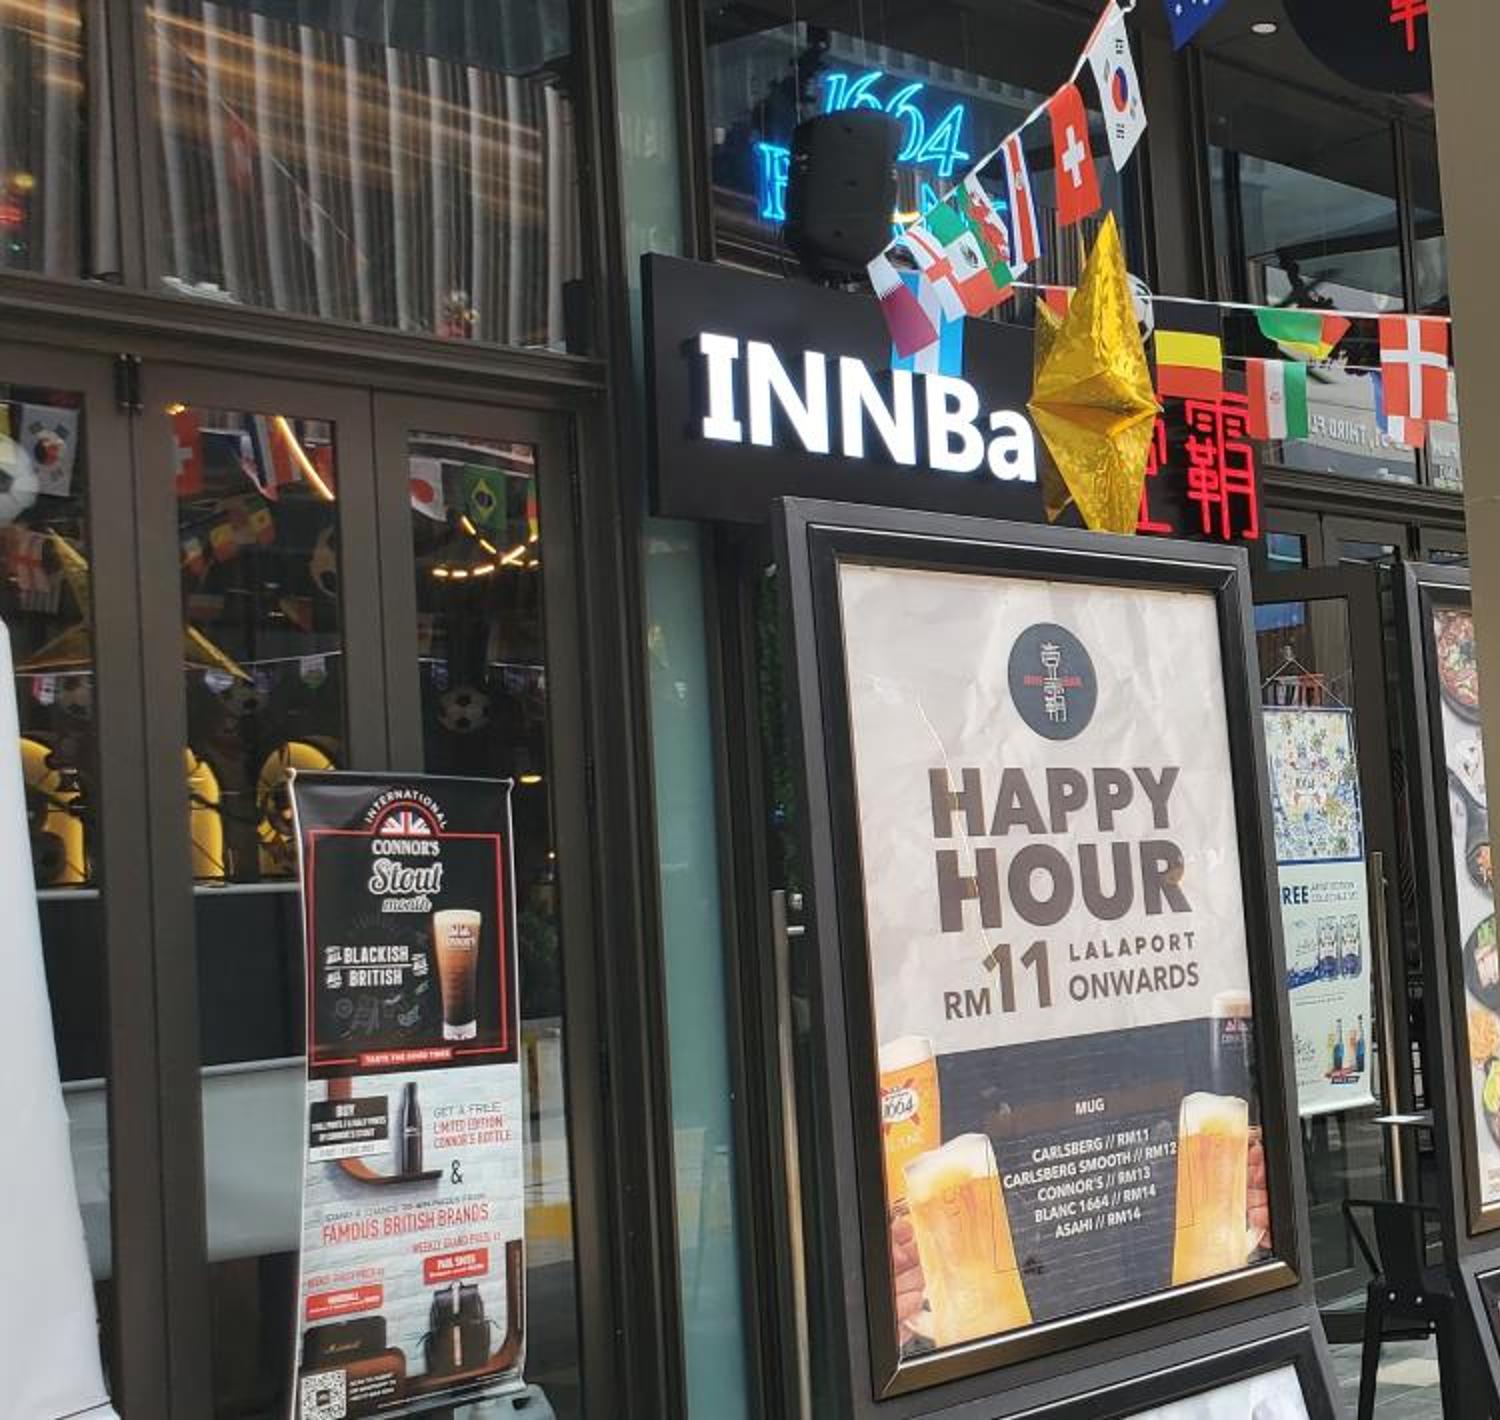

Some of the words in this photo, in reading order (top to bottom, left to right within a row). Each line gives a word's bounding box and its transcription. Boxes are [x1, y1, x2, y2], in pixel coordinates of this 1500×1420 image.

[364, 789, 447, 829] INTERNATIONAL
[928, 766, 1180, 838] HAPPY
[371, 839, 440, 856] CONNOR'S
[368, 857, 443, 895] Stout
[935, 839, 1192, 933] HOUR
[381, 894, 432, 912] month
[1282, 885, 1309, 905] REE
[343, 945, 409, 964] BLACKISH
[1069, 932, 1196, 962] LALAPORT
[349, 969, 403, 987] BRITISH
[1069, 962, 1199, 1001] ONWARDS
[1075, 1098, 1105, 1115] MUG
[1032, 1137, 1103, 1163] CARLSBERG
[1117, 1128, 1149, 1146] RM11
[450, 1160, 464, 1185] &
[1004, 1162, 1077, 1189] CARLSBERG
[1079, 1151, 1131, 1173] SMOOTH
[1145, 1141, 1177, 1160] RM12
[1037, 1176, 1104, 1202] CONNOR'S
[1117, 1165, 1151, 1184] RM13
[1035, 1203, 1076, 1223] BLANC
[1080, 1194, 1109, 1213] 1664
[1123, 1183, 1156, 1203] RM14
[323, 1219, 379, 1246] FAMOUS
[383, 1212, 435, 1235] BRITISH
[438, 1203, 489, 1227] BRANDS
[1055, 1218, 1093, 1239] ASAHI
[1107, 1206, 1141, 1226] RM14
